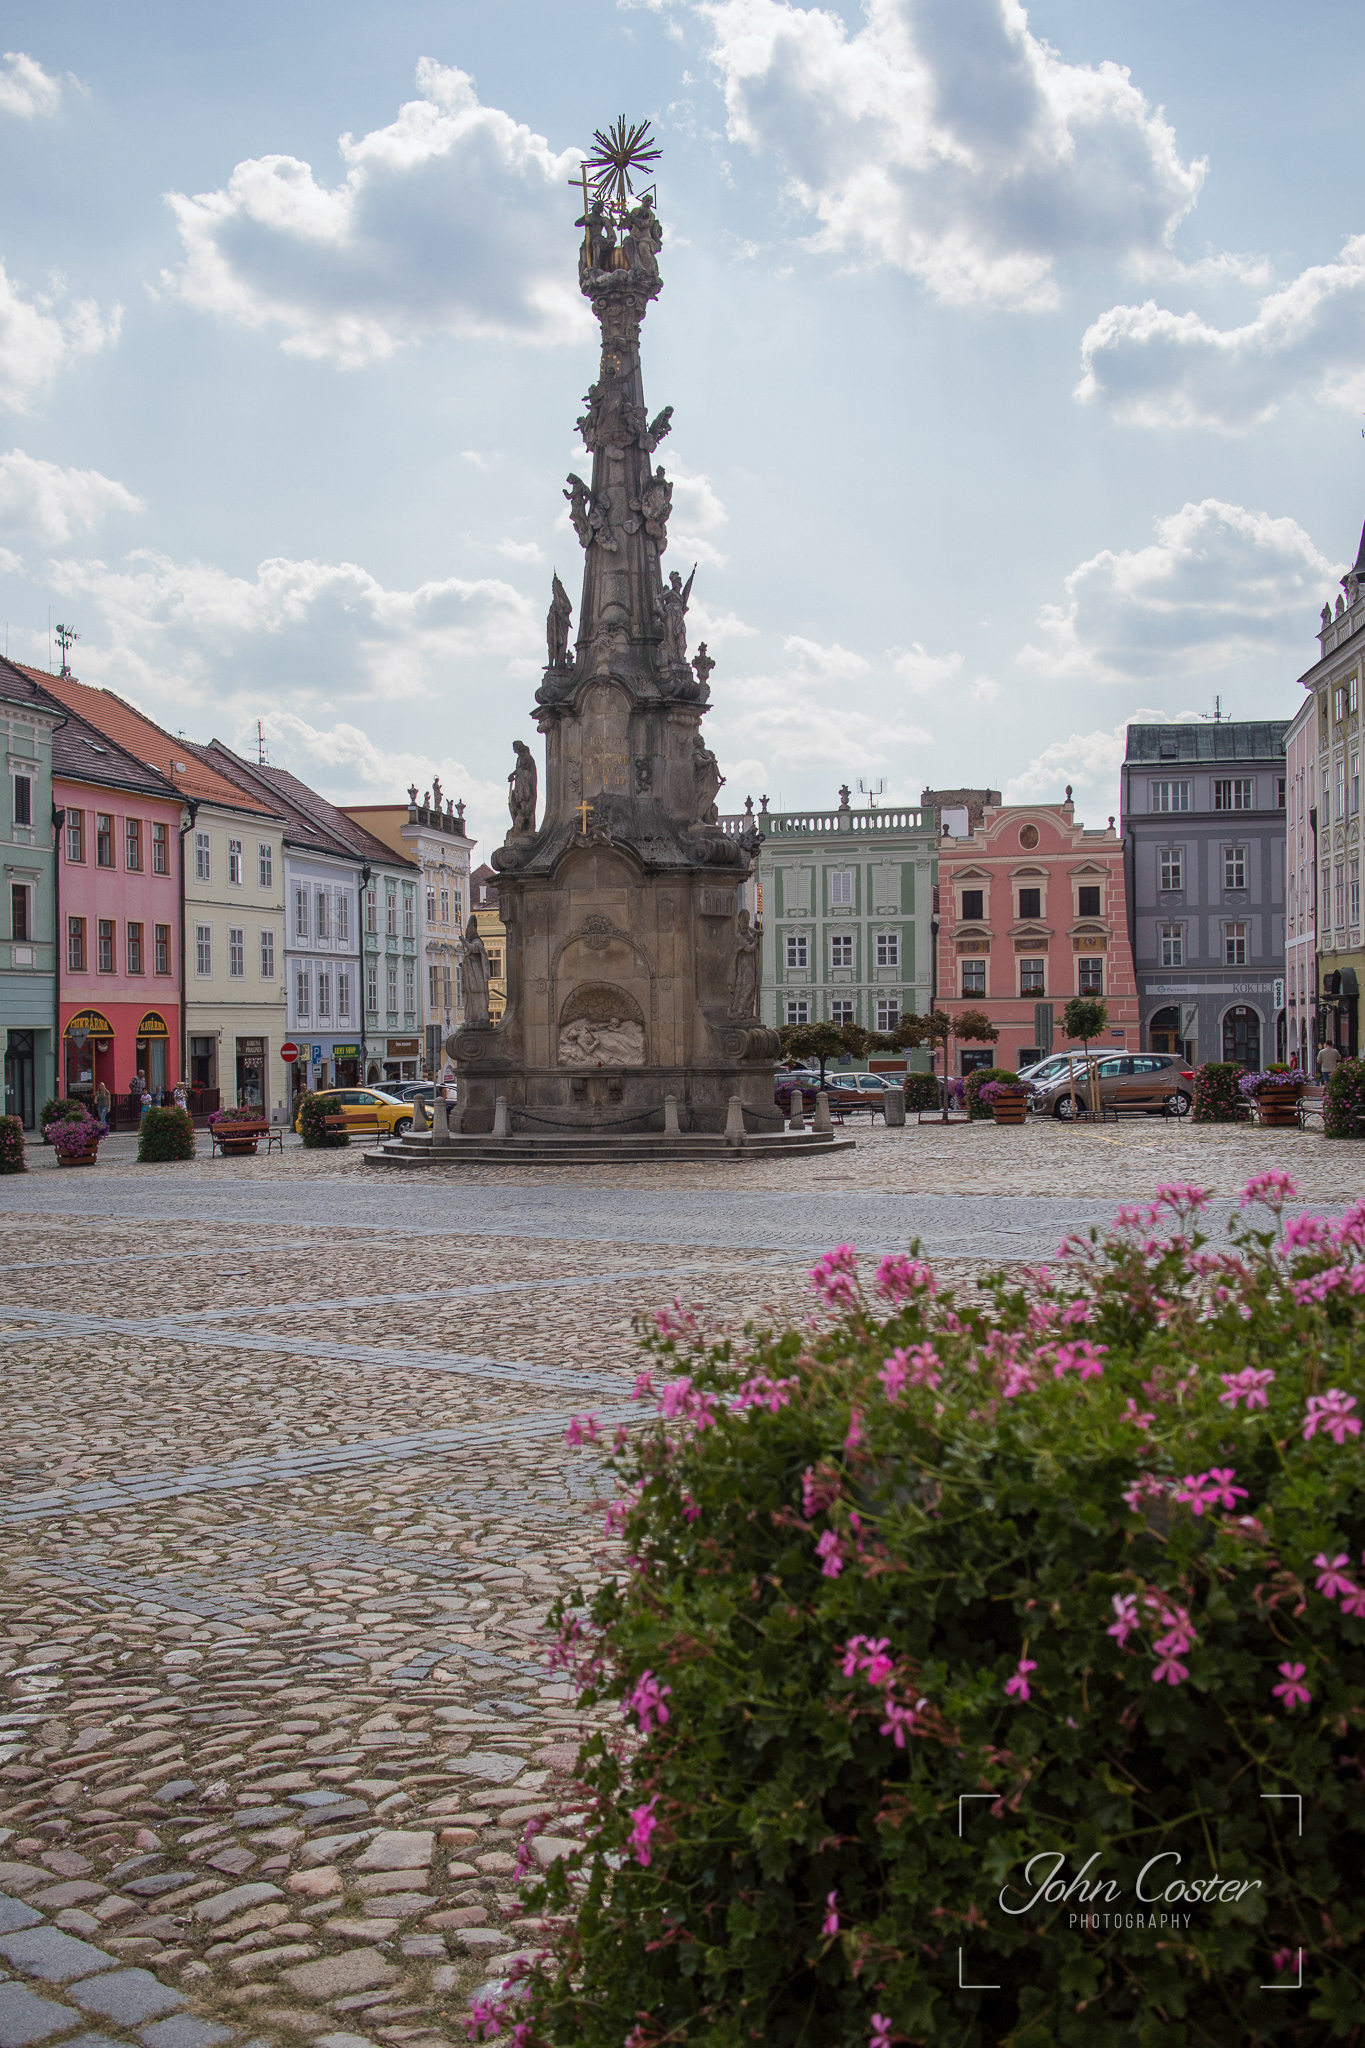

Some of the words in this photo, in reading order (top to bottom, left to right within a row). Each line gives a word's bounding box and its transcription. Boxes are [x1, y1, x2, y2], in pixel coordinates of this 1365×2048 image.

[70, 1013, 109, 1031] CUKRÁRNA
[140, 1017, 165, 1031] KAVÁRNA
[313, 1047, 320, 1058] P
